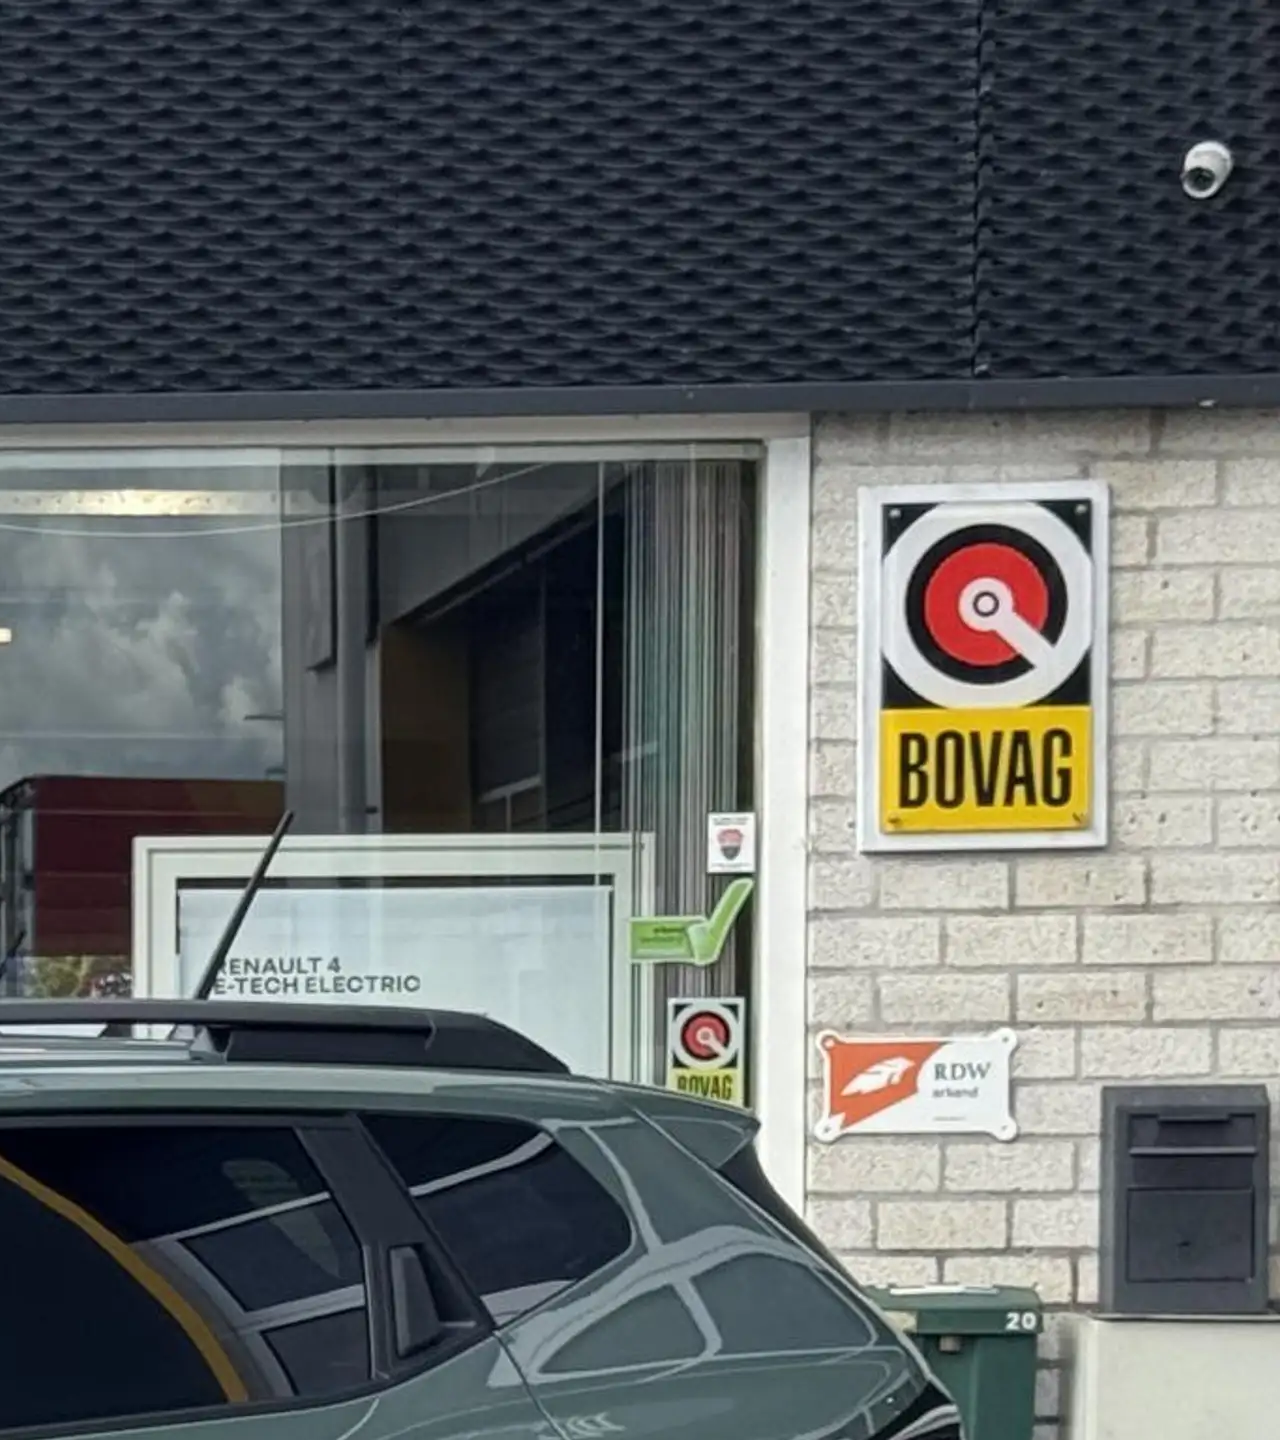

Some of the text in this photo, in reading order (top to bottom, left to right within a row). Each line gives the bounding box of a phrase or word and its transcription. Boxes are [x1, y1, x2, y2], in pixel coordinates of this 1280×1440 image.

[896, 728, 1073, 809] BOVAG
[327, 956, 342, 974] 4
[304, 975, 422, 994] ELECTRIC
[933, 1062, 993, 1082] RDW
[1005, 1312, 1039, 1332] 20
